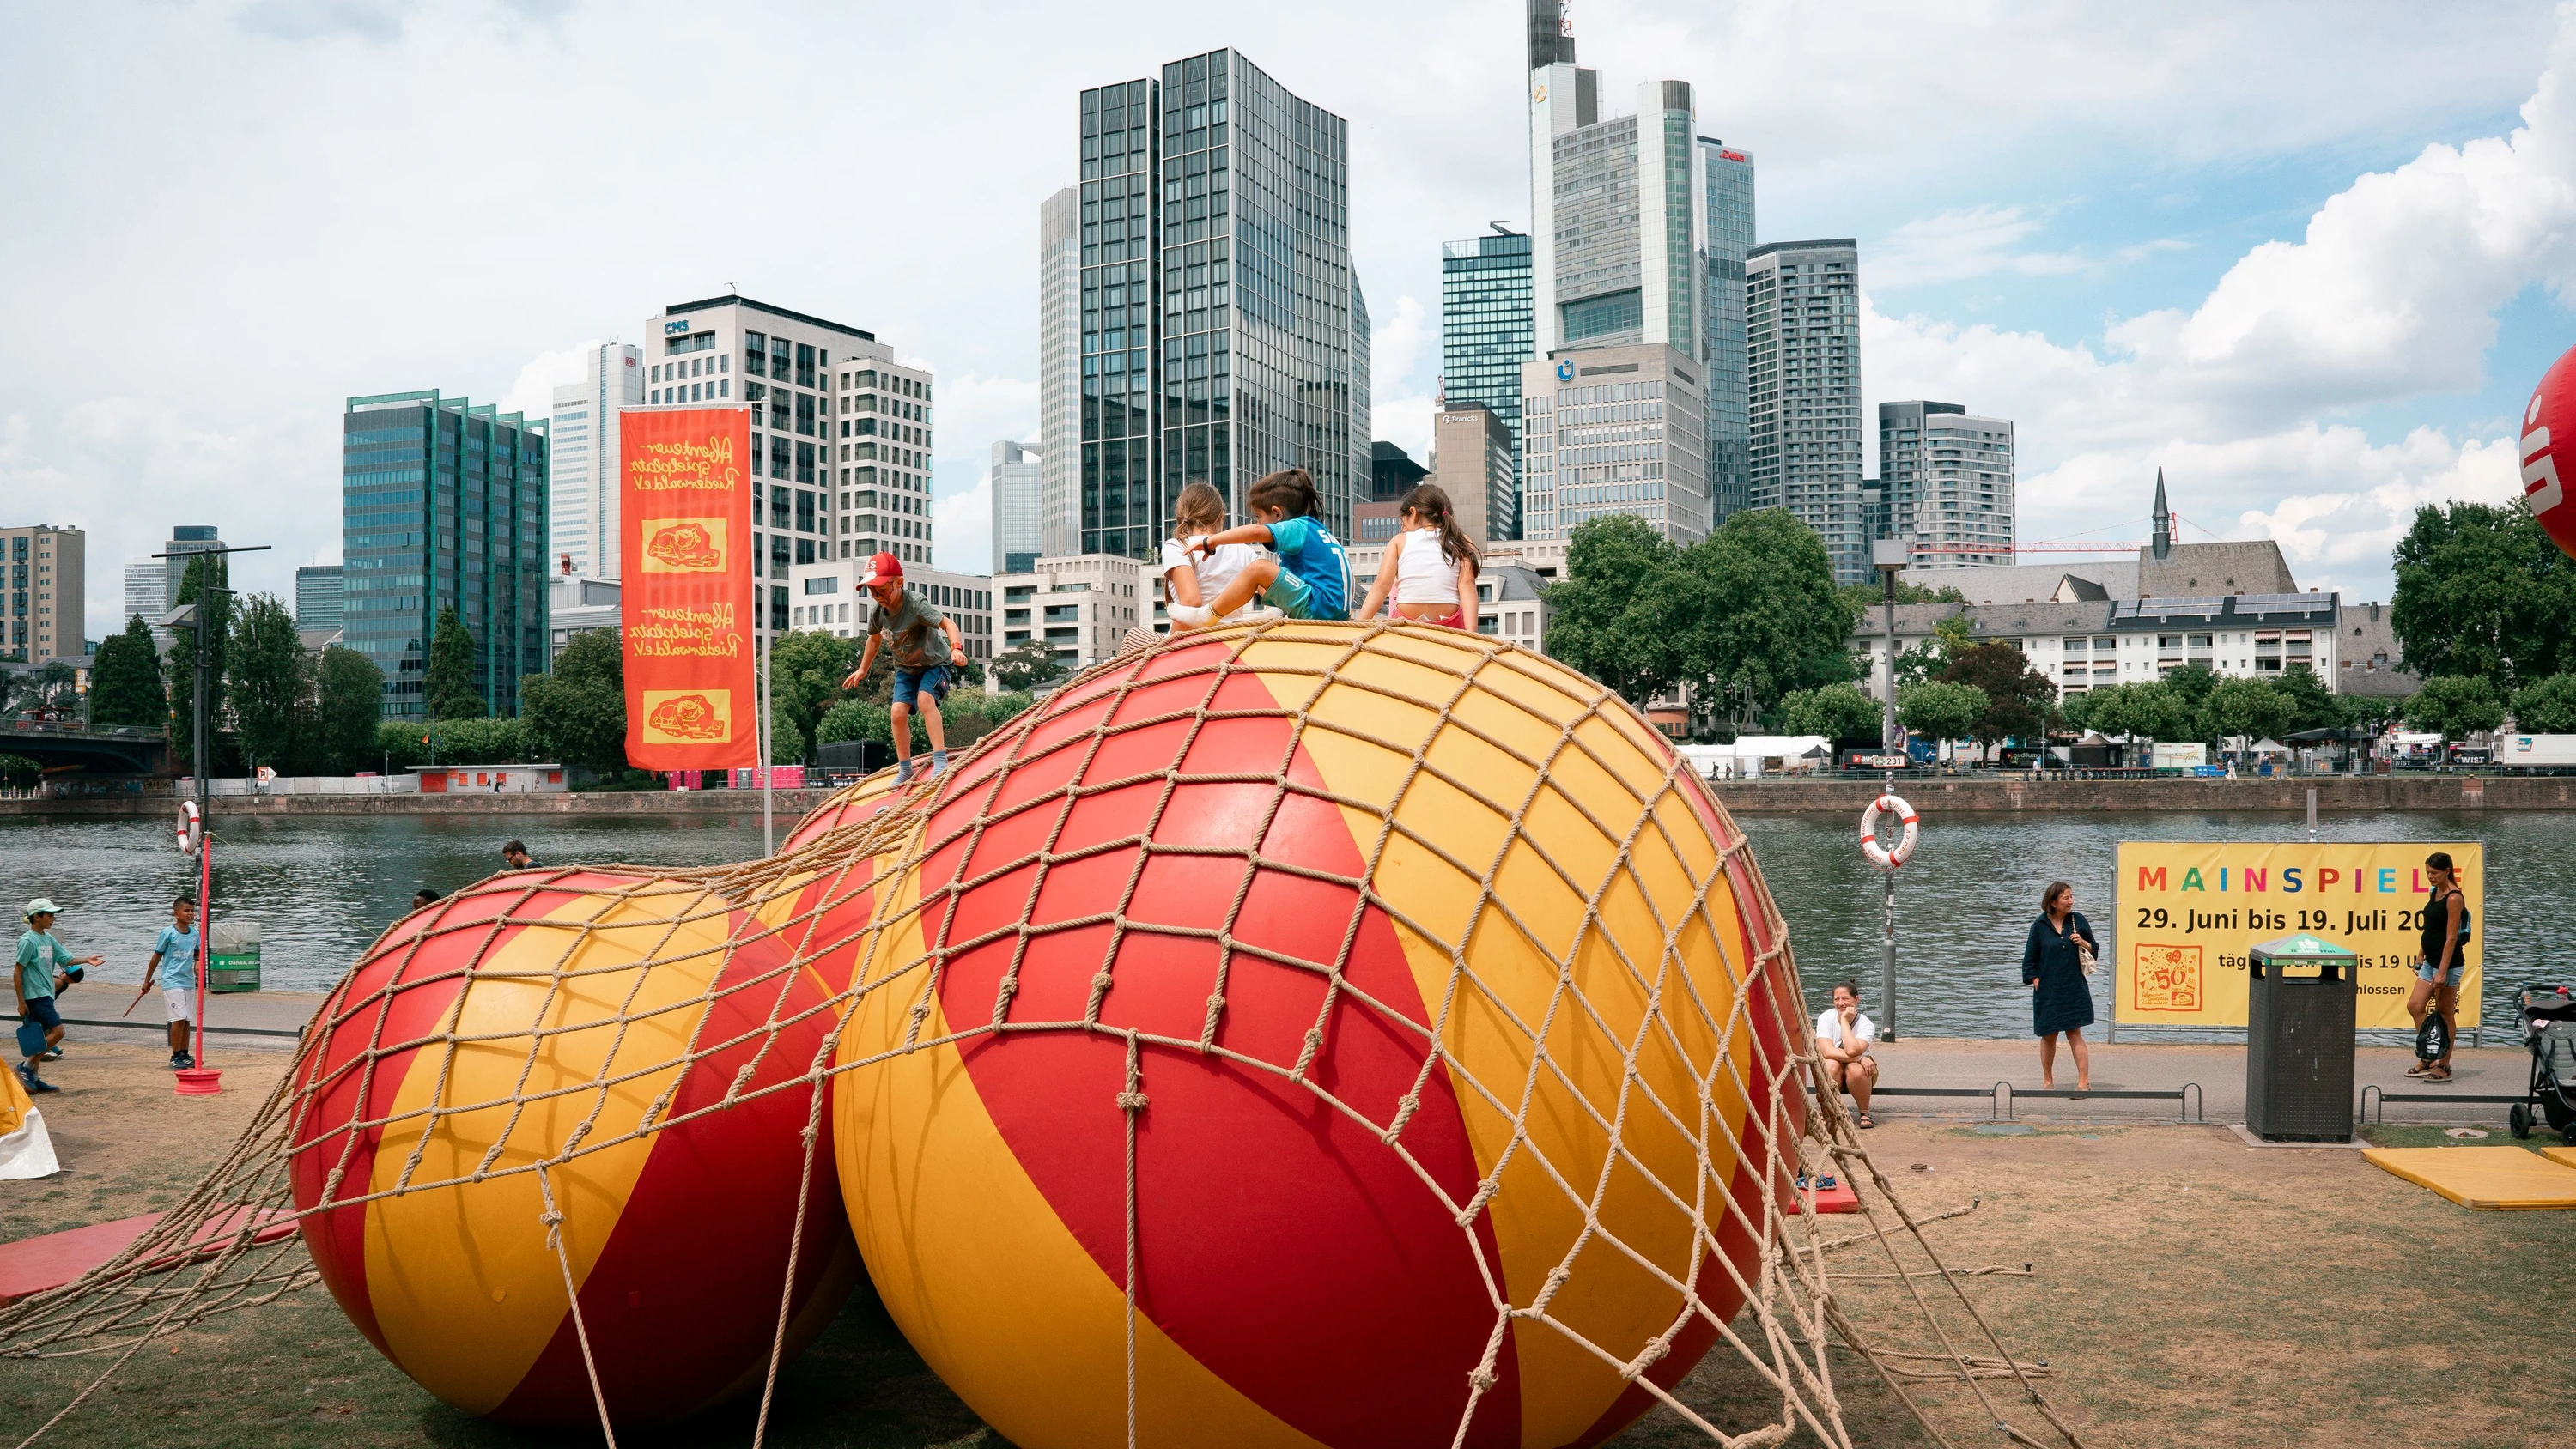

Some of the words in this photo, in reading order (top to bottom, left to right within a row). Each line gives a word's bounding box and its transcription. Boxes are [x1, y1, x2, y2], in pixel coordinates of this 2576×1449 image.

[1722, 149, 1746, 162] Deka
[664, 319, 690, 334] CMS
[2137, 908, 2177, 928] 29.
[2185, 909, 2238, 934] Juni
[2249, 909, 2286, 930] bis
[2297, 910, 2336, 931] 19.
[2344, 910, 2387, 936] Juli
[2397, 910, 2425, 931] 20
[2379, 955, 2395, 968] 19
[2154, 968, 2186, 990] 50
[2356, 984, 2405, 995] hlossen
